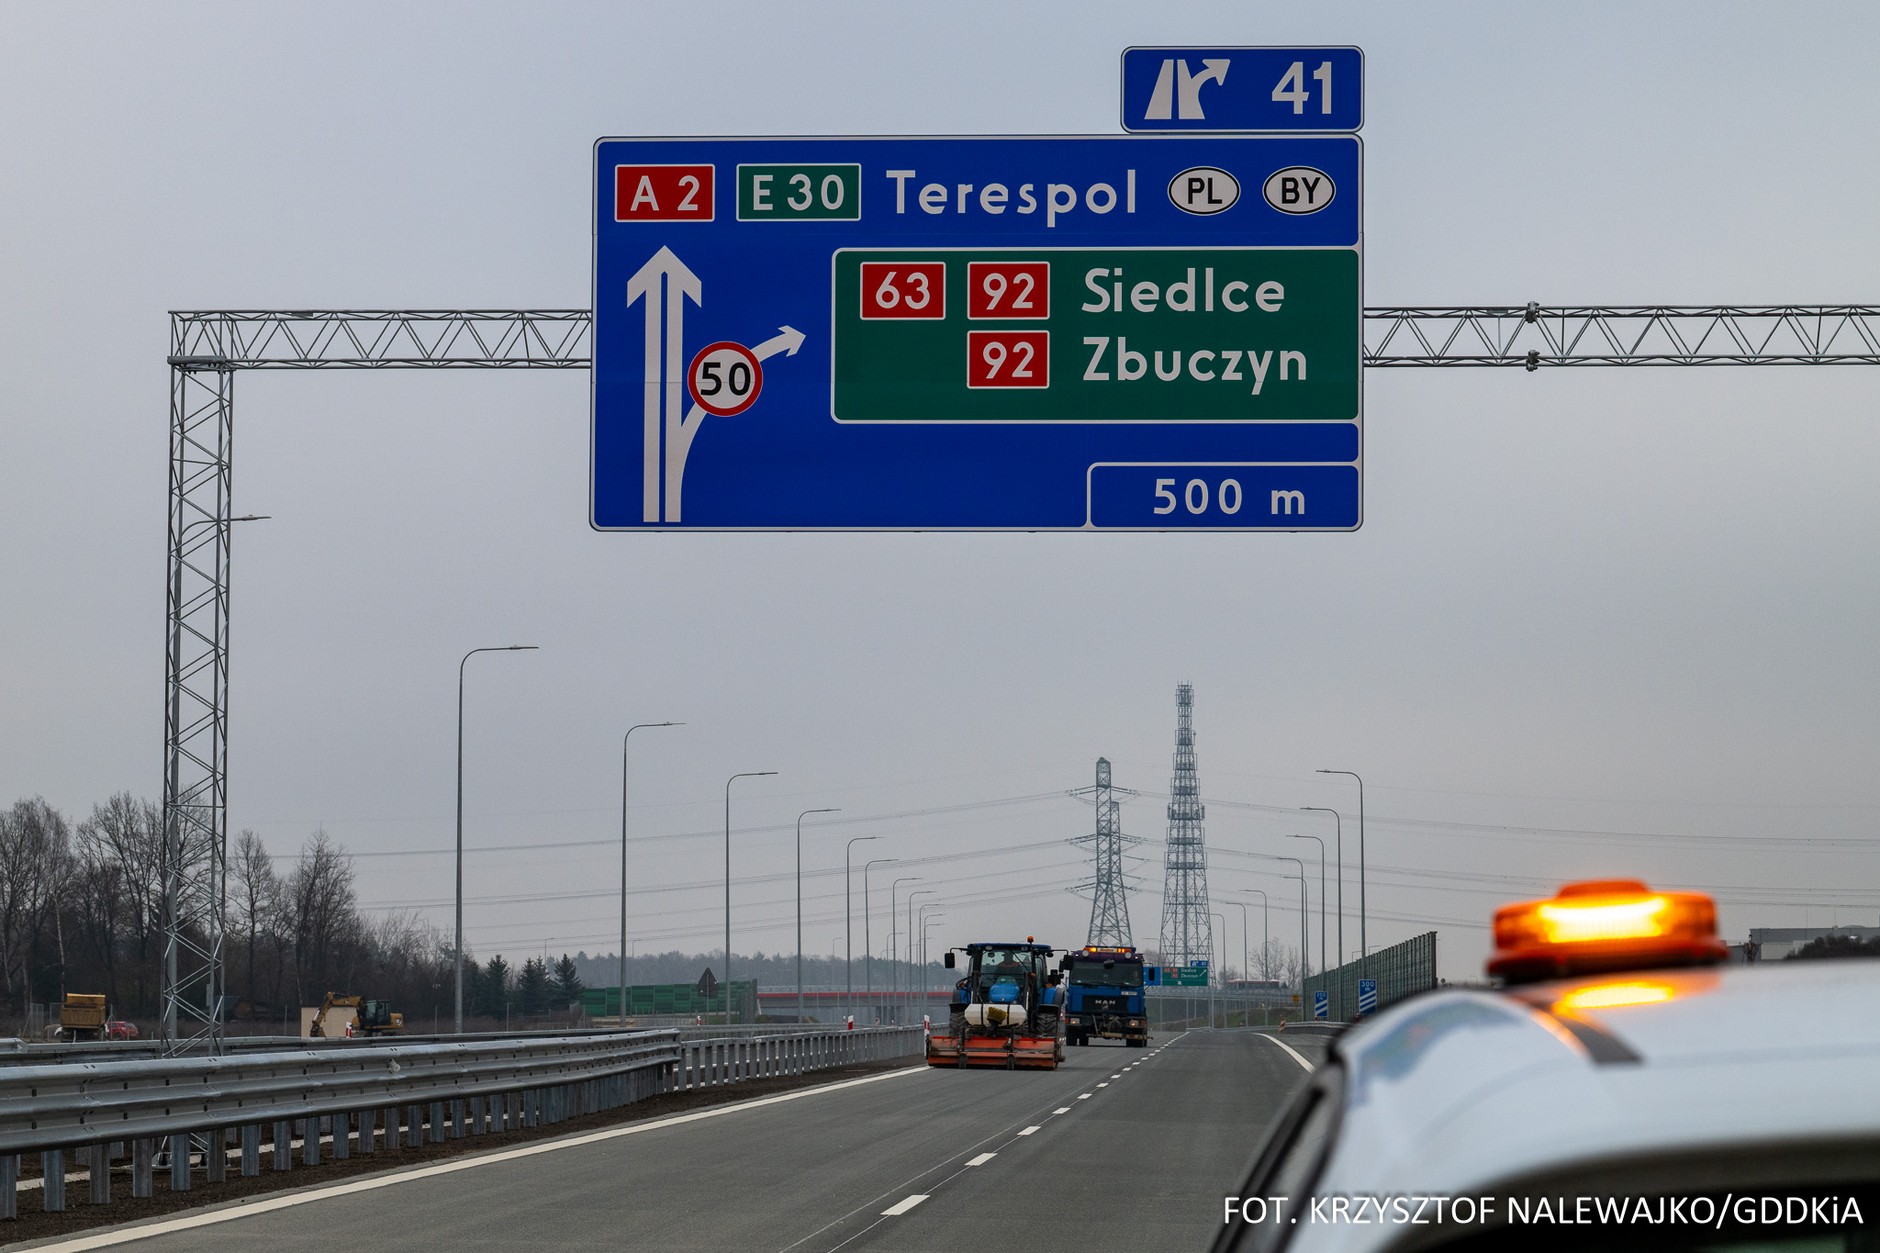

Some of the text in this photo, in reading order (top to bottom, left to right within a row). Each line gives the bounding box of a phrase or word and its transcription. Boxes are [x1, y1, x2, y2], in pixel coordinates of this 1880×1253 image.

[1271, 61, 1332, 115] 41
[630, 175, 700, 211] A 2
[753, 173, 844, 211] E 30
[886, 169, 1136, 228] Terespol
[1187, 177, 1223, 205] PL
[1281, 176, 1321, 205] BY
[875, 271, 930, 310] 63
[983, 272, 1035, 310] 92
[1081, 267, 1285, 313] Siedlce
[700, 361, 751, 396] 50
[982, 341, 1034, 379] 92
[1083, 336, 1307, 395] Zbuczyn
[1153, 478, 1305, 515] 500 m
